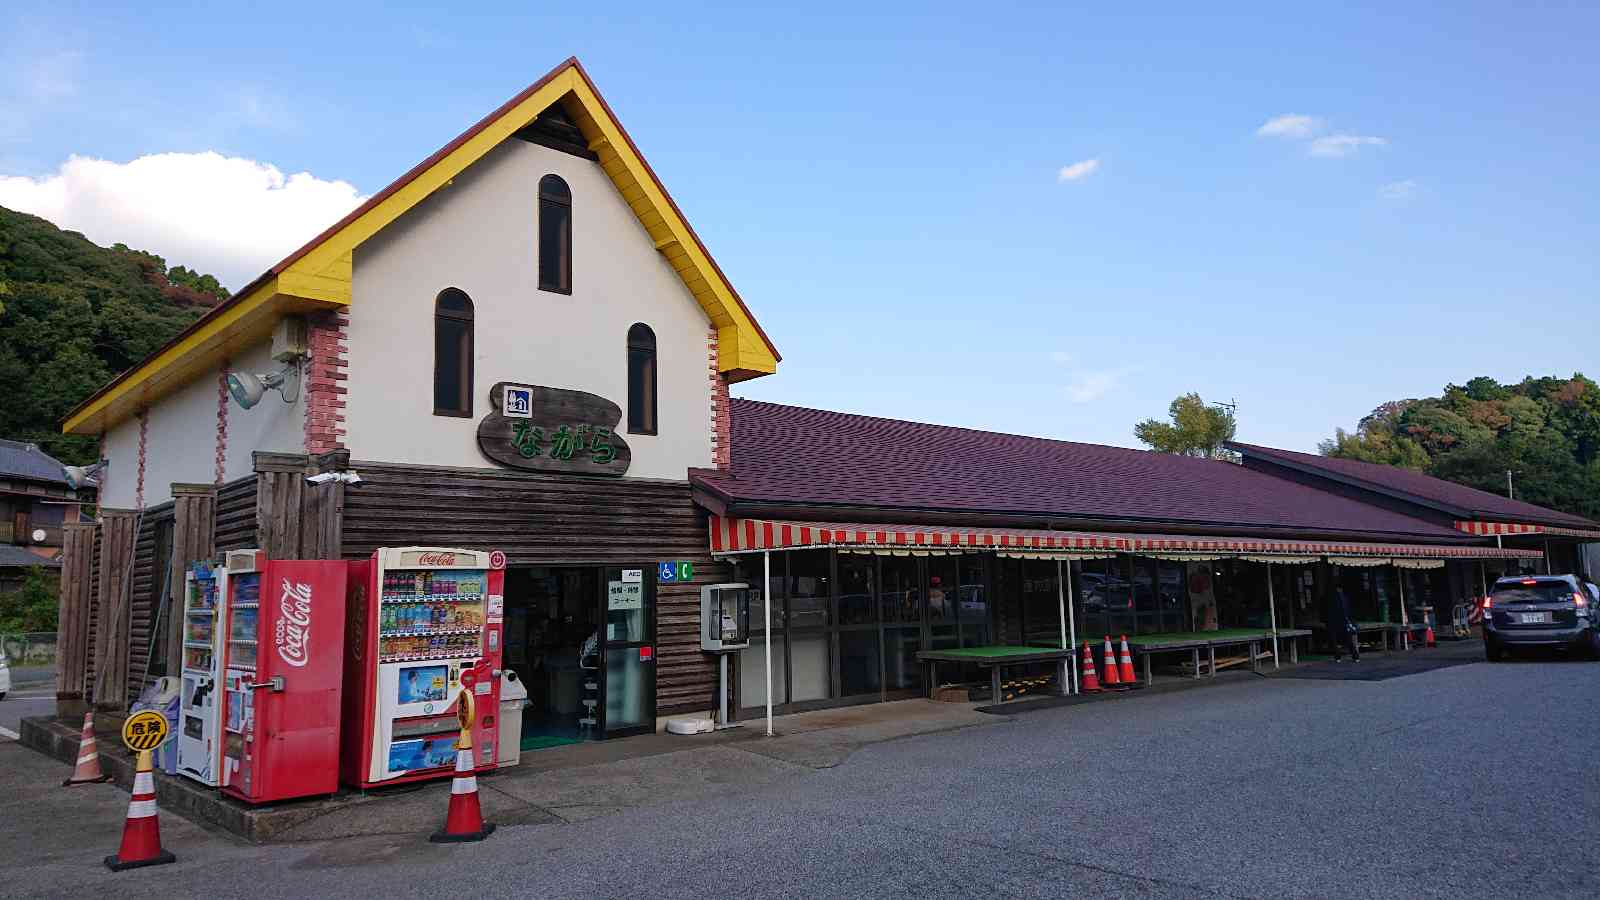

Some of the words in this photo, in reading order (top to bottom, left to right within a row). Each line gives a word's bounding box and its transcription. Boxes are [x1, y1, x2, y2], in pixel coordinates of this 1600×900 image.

[511, 418, 616, 464] ながら
[417, 552, 456, 566] Coca-Cola
[279, 577, 312, 667] Coca-Cola
[131, 720, 161, 736] 危険
